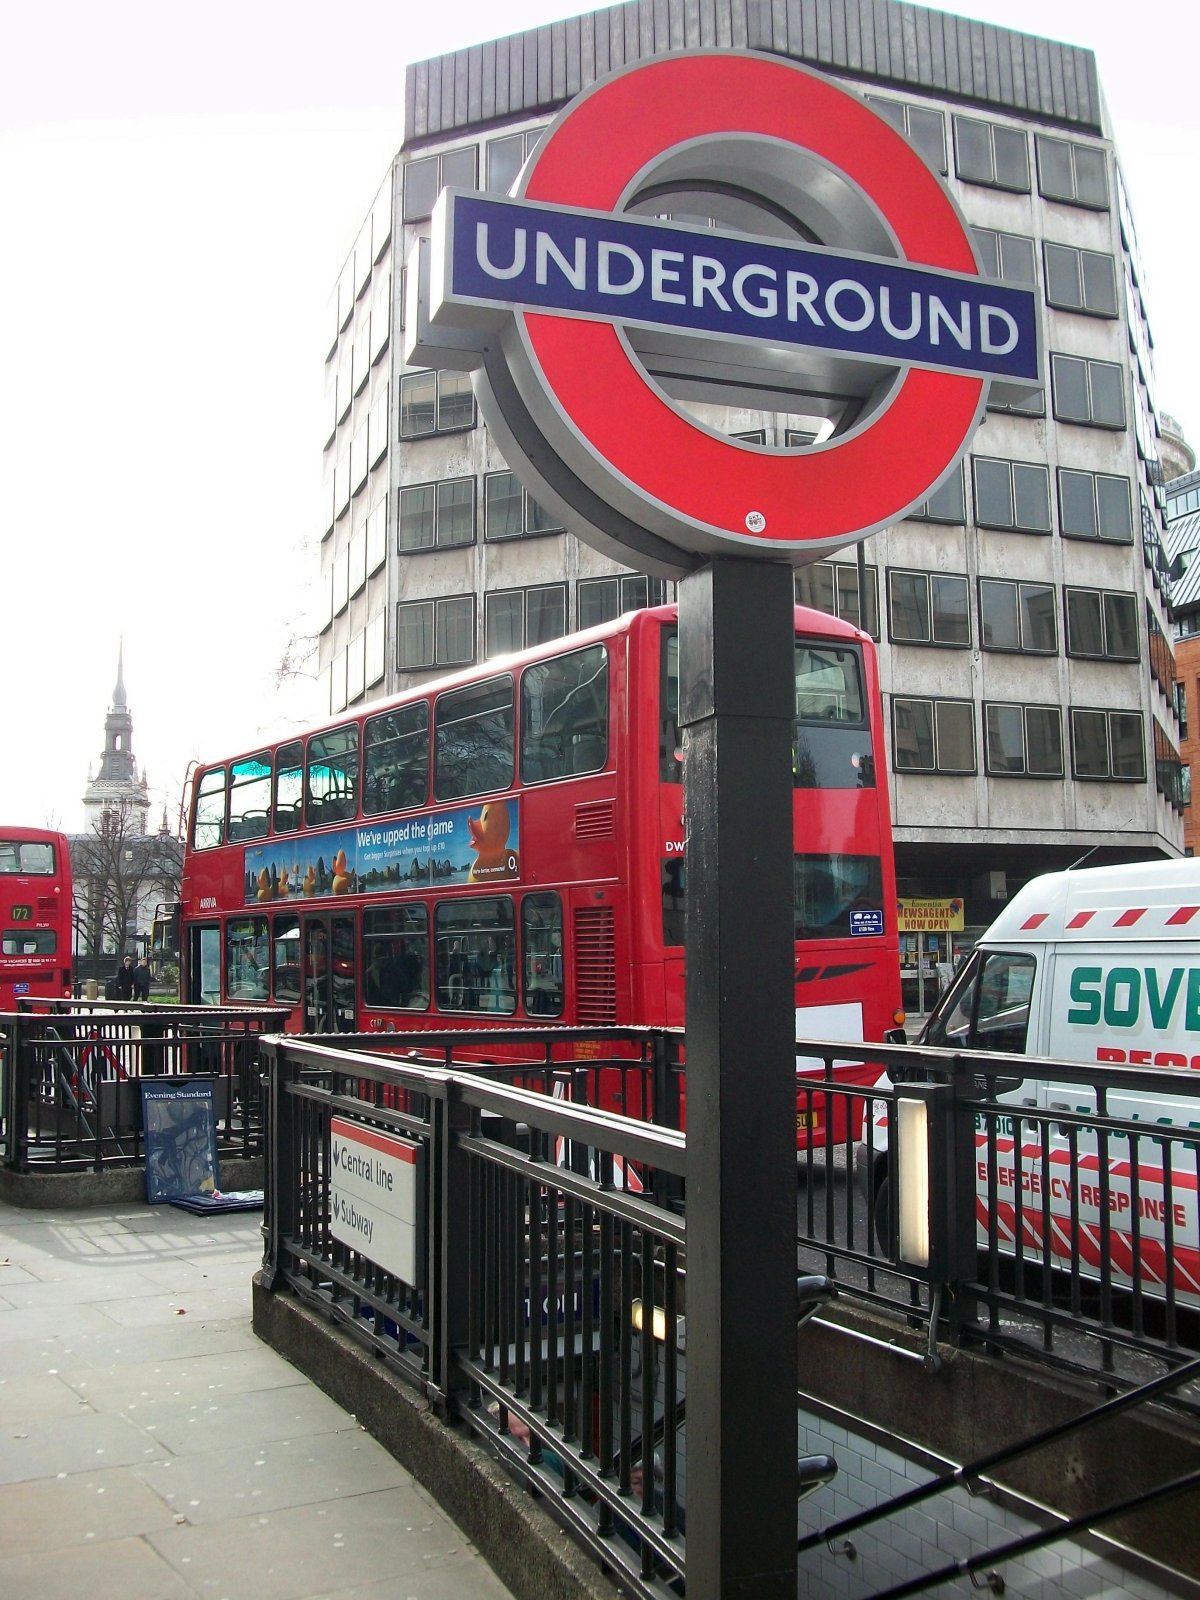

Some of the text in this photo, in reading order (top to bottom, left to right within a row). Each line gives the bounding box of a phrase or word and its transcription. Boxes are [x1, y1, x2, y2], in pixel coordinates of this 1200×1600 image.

[475, 220, 1021, 357] UNDERGROUND
[357, 820, 454, 848] We've upped the game
[402, 845, 414, 856] when
[414, 845, 423, 856] you
[199, 896, 217, 910] ARRIVA
[12, 908, 28, 920] 172
[904, 919, 950, 930] NOW OPEN
[144, 1089, 212, 1100] Evening Standard
[341, 1145, 394, 1193] Central line
[977, 1161, 1072, 1201] EERGECY
[341, 1198, 374, 1245] Subway
